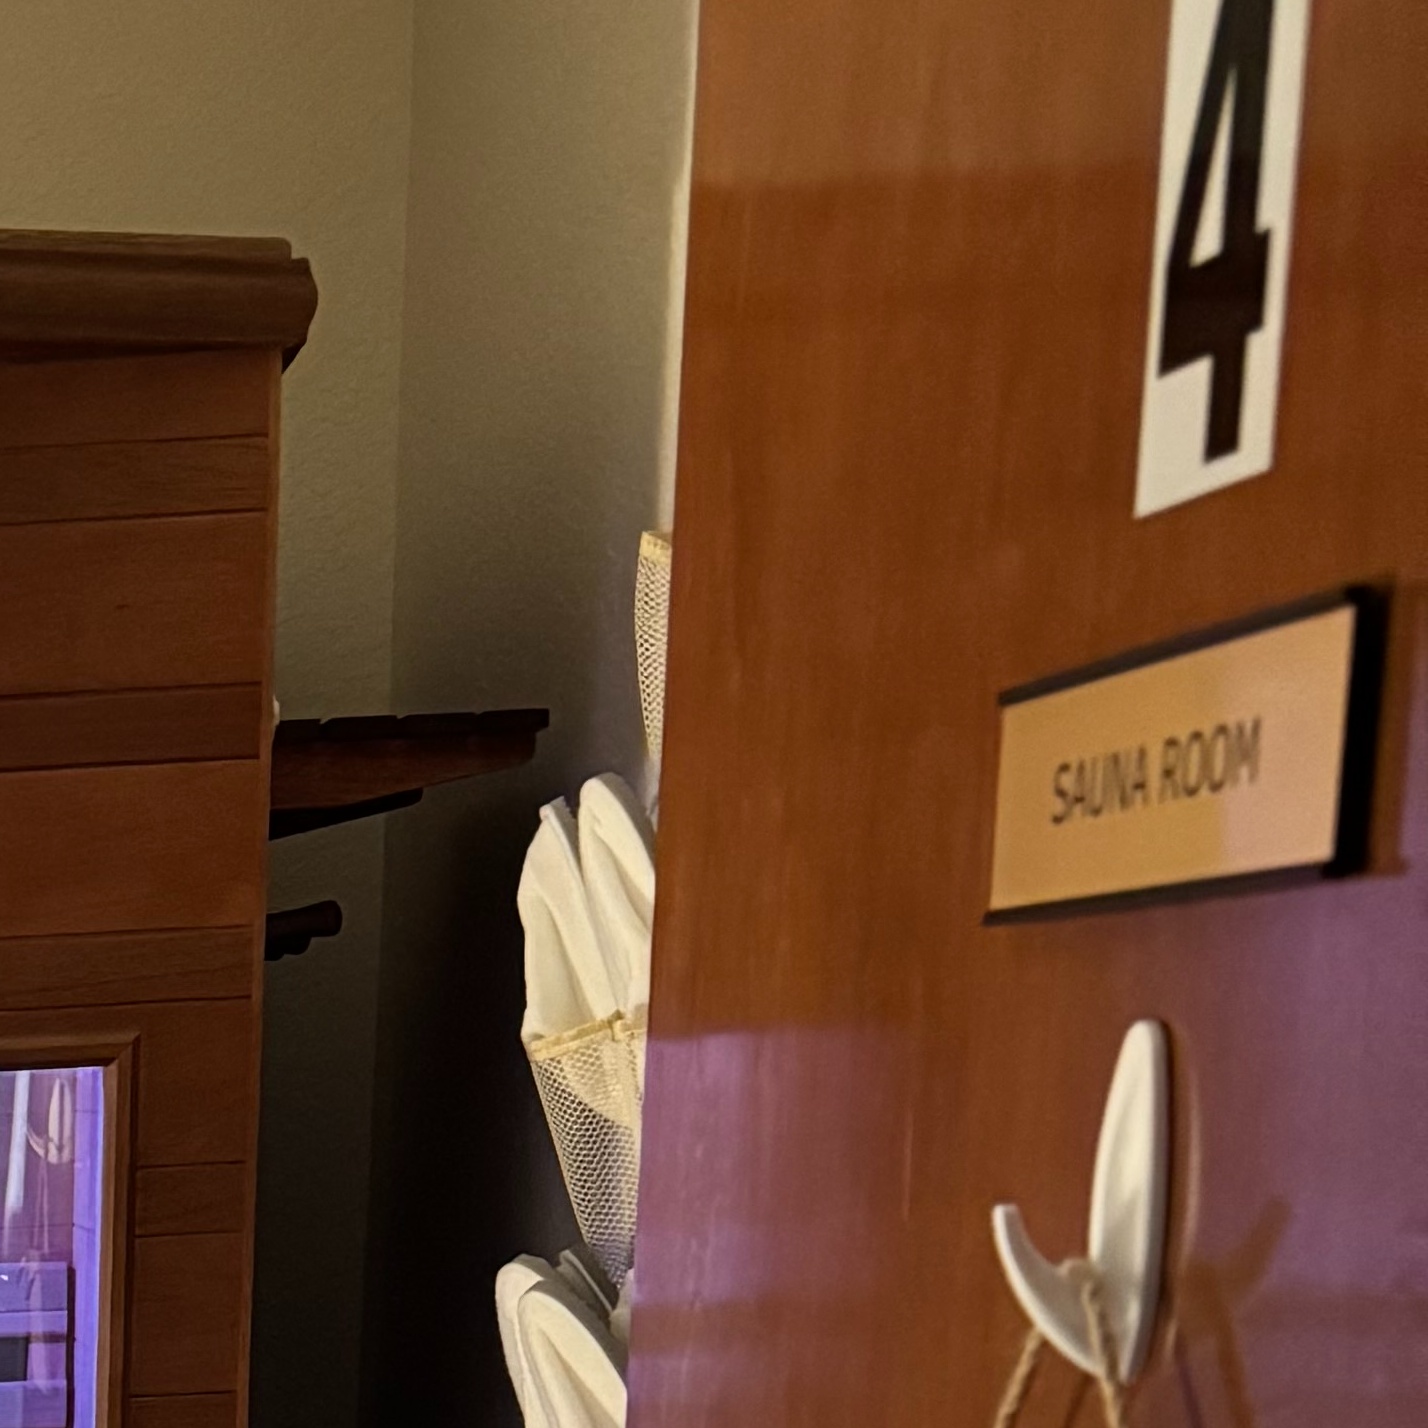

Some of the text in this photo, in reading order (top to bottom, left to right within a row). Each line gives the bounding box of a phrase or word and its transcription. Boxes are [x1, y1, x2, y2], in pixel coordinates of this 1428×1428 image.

[1158, 0, 1275, 464] 4
[1052, 714, 1262, 825] SAUNA ROOM
